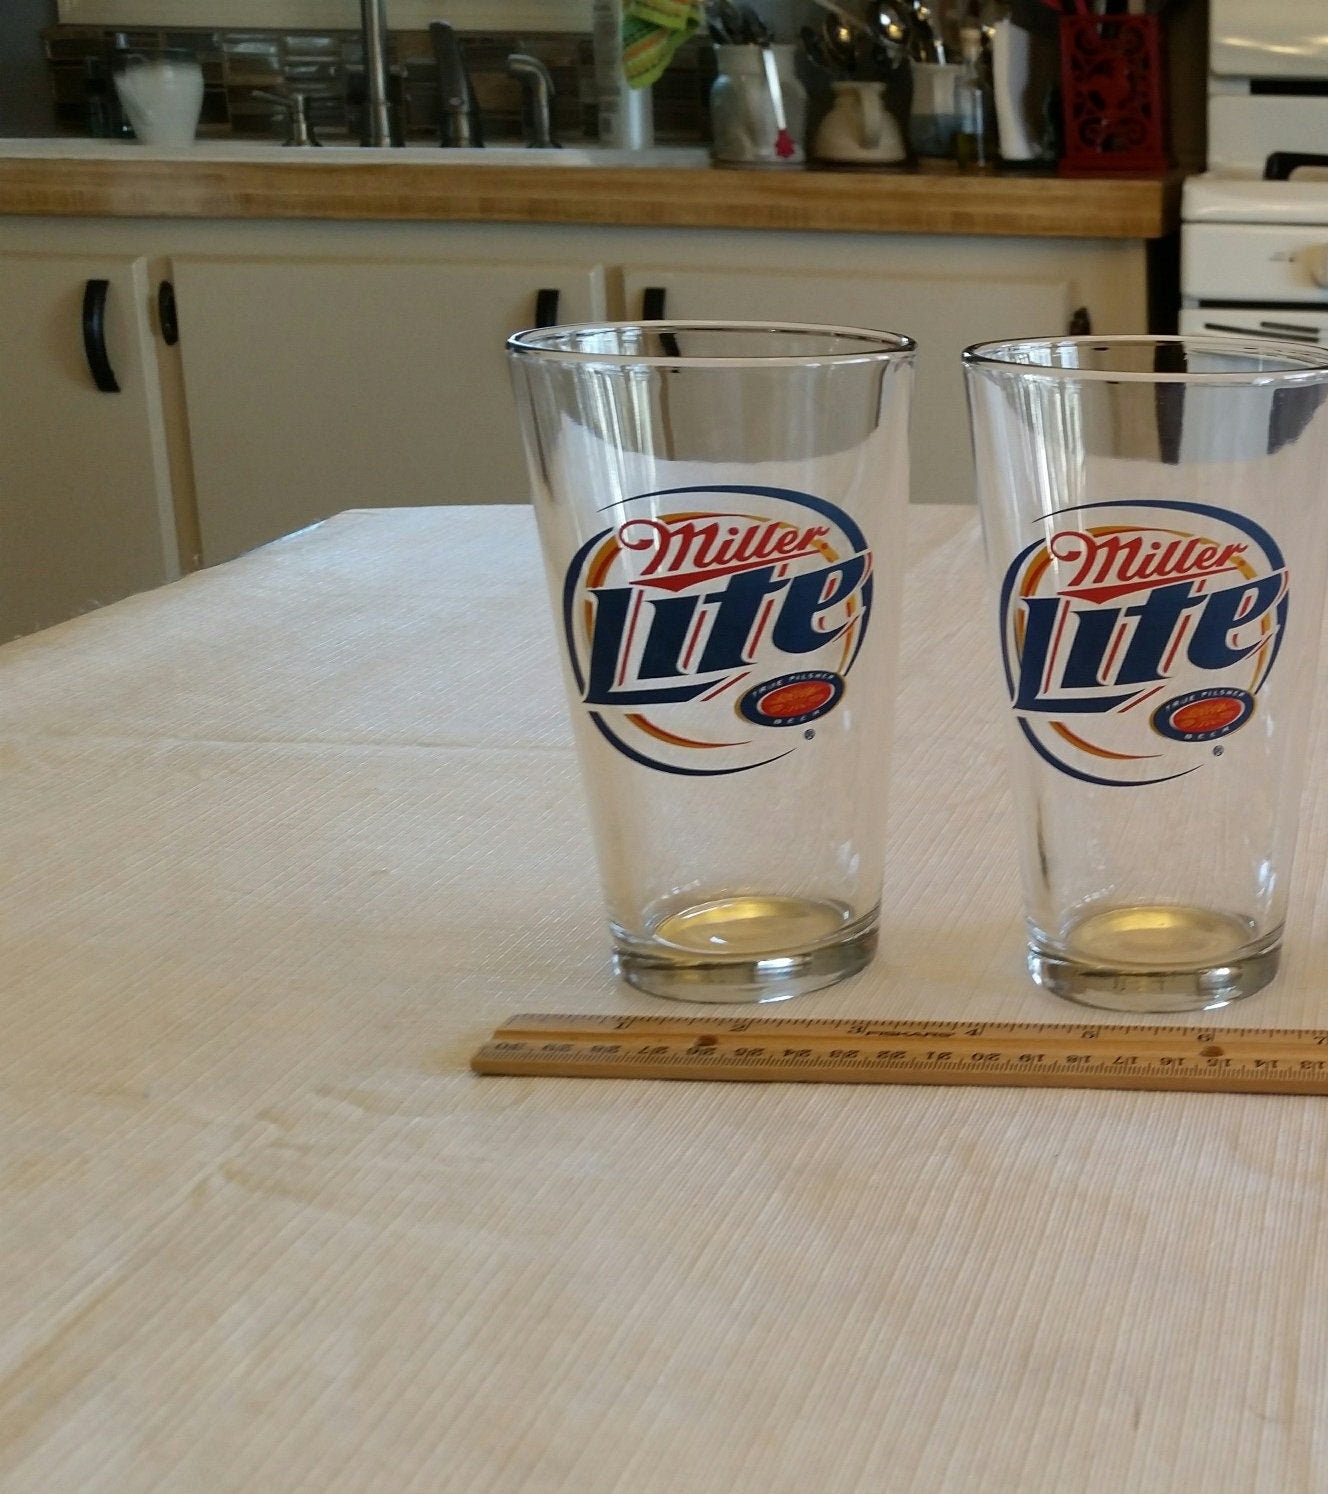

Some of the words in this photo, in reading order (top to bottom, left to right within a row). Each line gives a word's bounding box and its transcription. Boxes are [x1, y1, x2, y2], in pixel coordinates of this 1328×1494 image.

[619, 519, 829, 576] Miller
[1050, 531, 1248, 586] Miller
[583, 552, 868, 705] Lite
[1012, 570, 1286, 713] Lite
[788, 673, 835, 681] PILSNER
[1201, 689, 1246, 698] PILSNER
